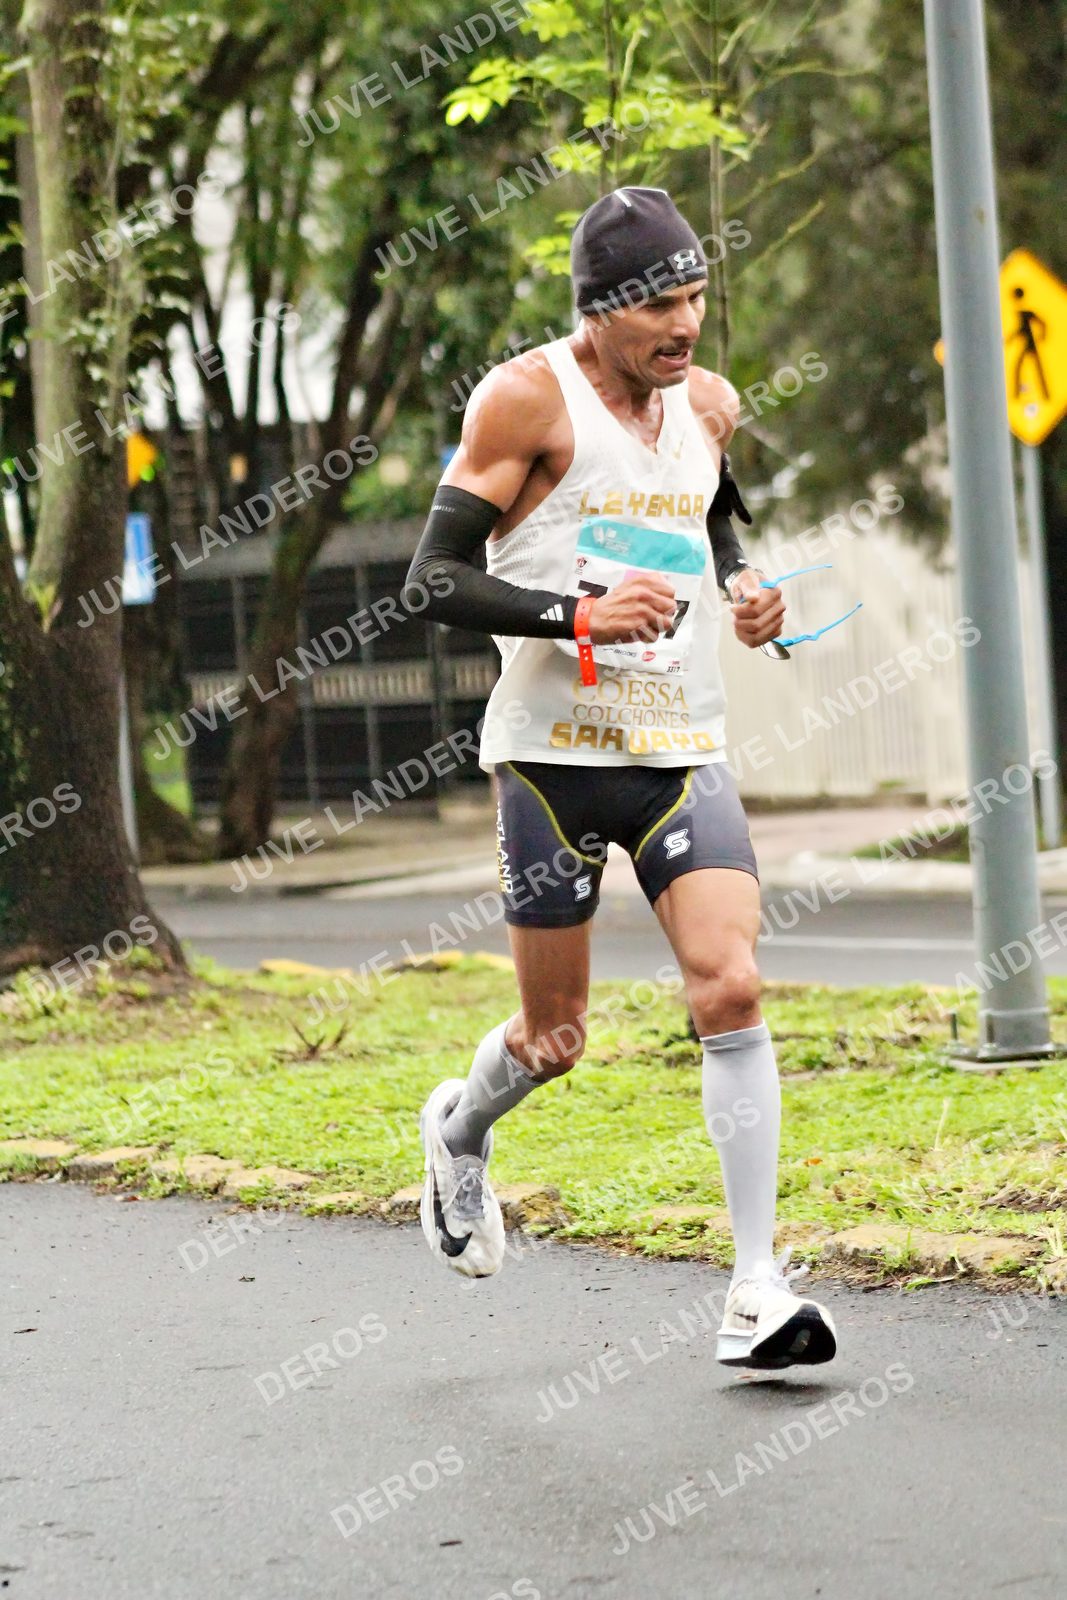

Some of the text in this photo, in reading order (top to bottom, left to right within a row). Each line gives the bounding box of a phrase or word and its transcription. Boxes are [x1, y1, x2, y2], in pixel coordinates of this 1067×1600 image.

[578, 491, 705, 518] LEYENDA
[573, 703, 690, 729] COLCHONES
[550, 722, 715, 755] SAHUAYO
